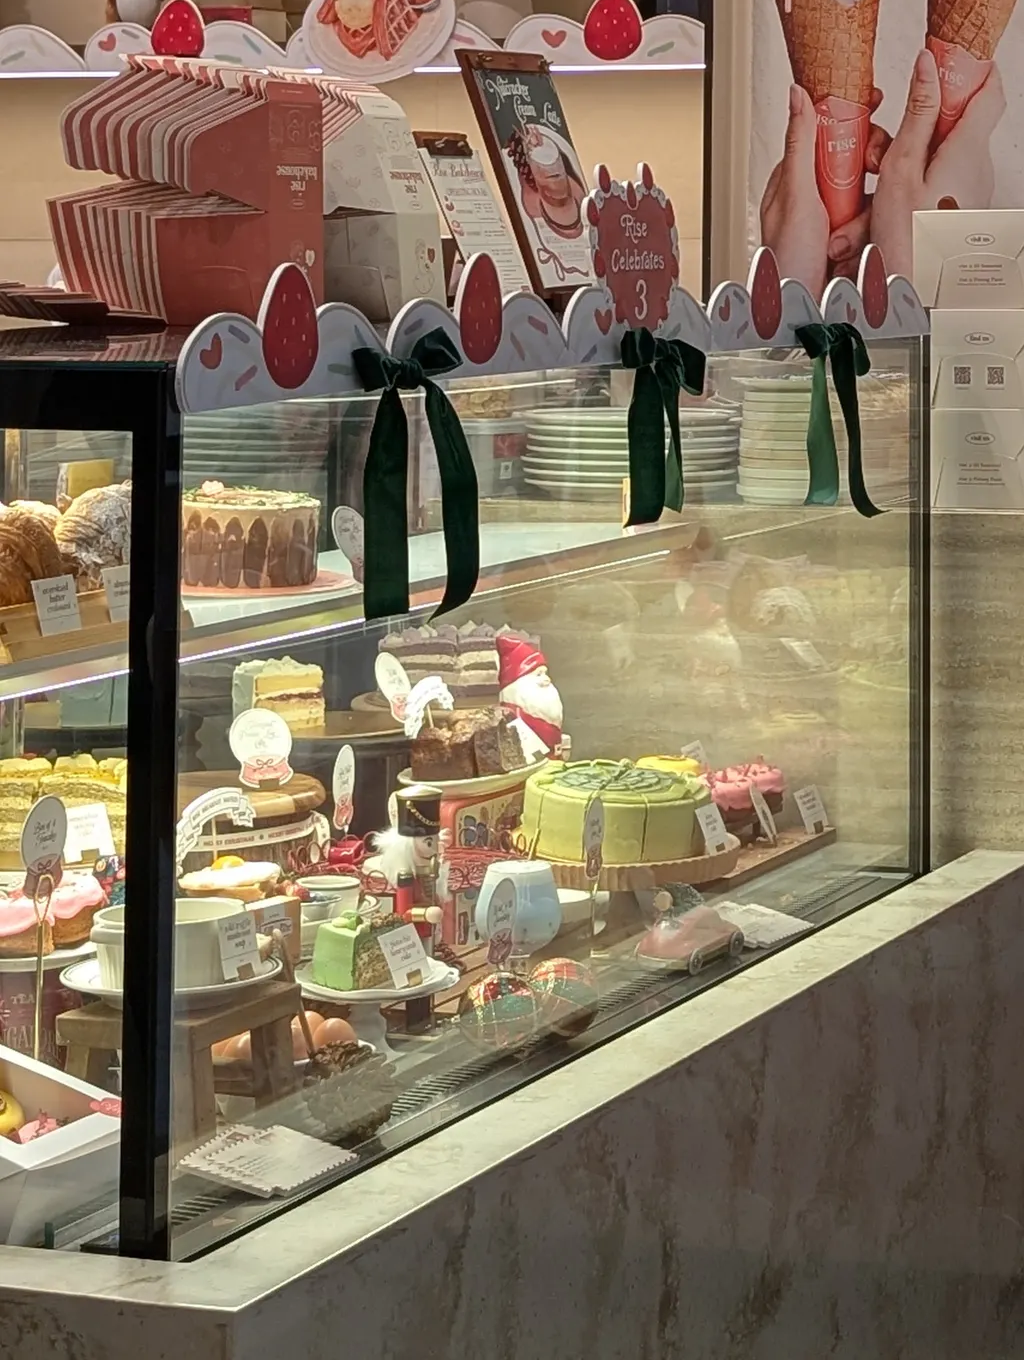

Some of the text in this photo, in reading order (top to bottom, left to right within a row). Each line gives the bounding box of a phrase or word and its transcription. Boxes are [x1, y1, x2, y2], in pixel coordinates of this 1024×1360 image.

[276, 165, 317, 180] bakehouse
[389, 171, 424, 184] bakehouse
[290, 180, 306, 191] rise
[405, 184, 417, 194] rise
[621, 214, 648, 244] Rise
[611, 248, 665, 272] Celebrates
[635, 279, 648, 320] 3
